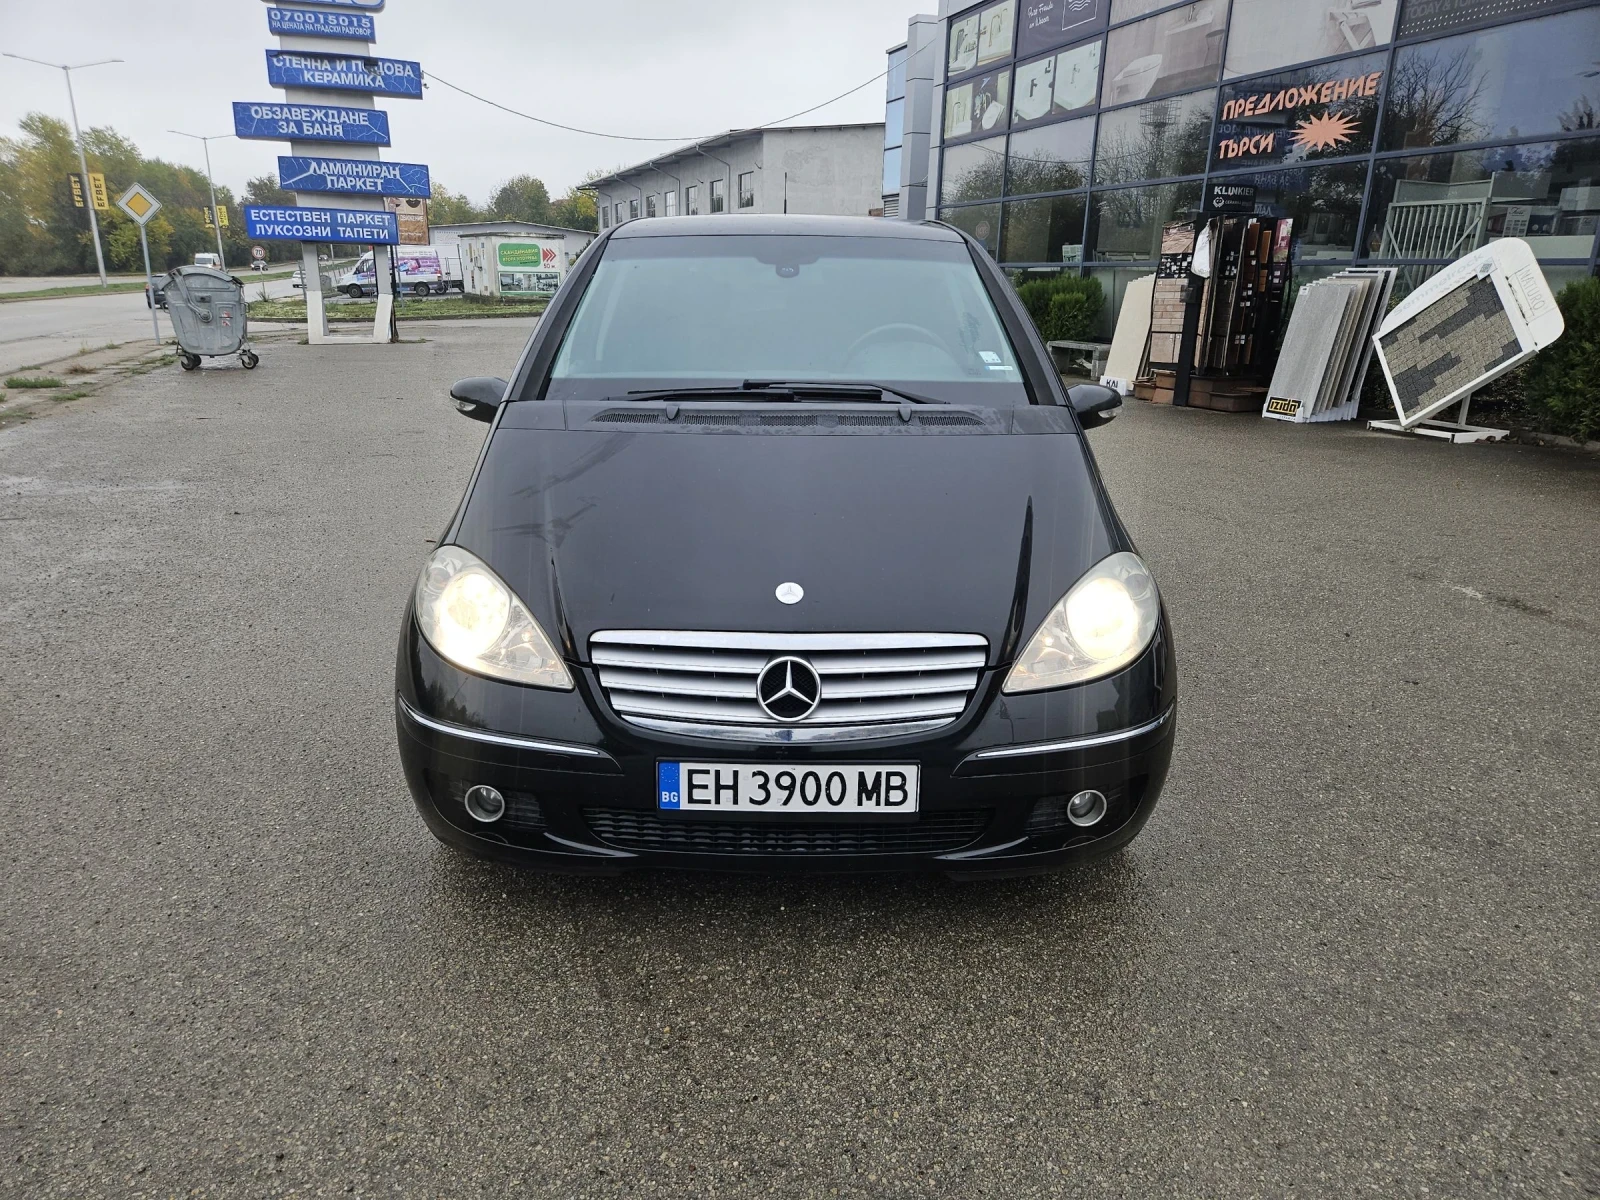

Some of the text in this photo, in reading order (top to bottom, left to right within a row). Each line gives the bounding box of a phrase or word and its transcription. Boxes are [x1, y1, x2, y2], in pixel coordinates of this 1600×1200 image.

[271, 10, 371, 28] 070015015
[282, 21, 304, 30] ЦЕНАТА
[306, 23, 314, 31] НА
[314, 24, 341, 33] ГРАДСКИ
[342, 26, 371, 36] РАЗГОВОР
[273, 56, 331, 71] СТЕННА
[337, 60, 347, 71] И
[304, 71, 385, 88] КЕРАМИКА
[1222, 70, 1384, 121] ПРЕДЛОЖЕНИЕ
[251, 106, 369, 125] ОБЗАВЕЖДАНЕ
[279, 121, 343, 136] ЗА БАНЯ
[1219, 132, 1275, 160] ТЪРСИ
[309, 161, 400, 179] ЛАМИНИРАН
[70, 175, 84, 207] EFBET
[92, 176, 106, 207] EFBET
[327, 176, 384, 191] ПАРКЕТ
[1213, 186, 1254, 196] KLINKIER
[251, 210, 390, 226] ЕСТЕСТВЕН ПАРКЕТ
[256, 224, 331, 237] ЛУКСОЗНИ
[337, 227, 389, 240] ТАПЕТИ
[1518, 268, 1546, 311] NATURO
[687, 769, 908, 807] EH 3900 MB
[661, 791, 678, 803] BG
